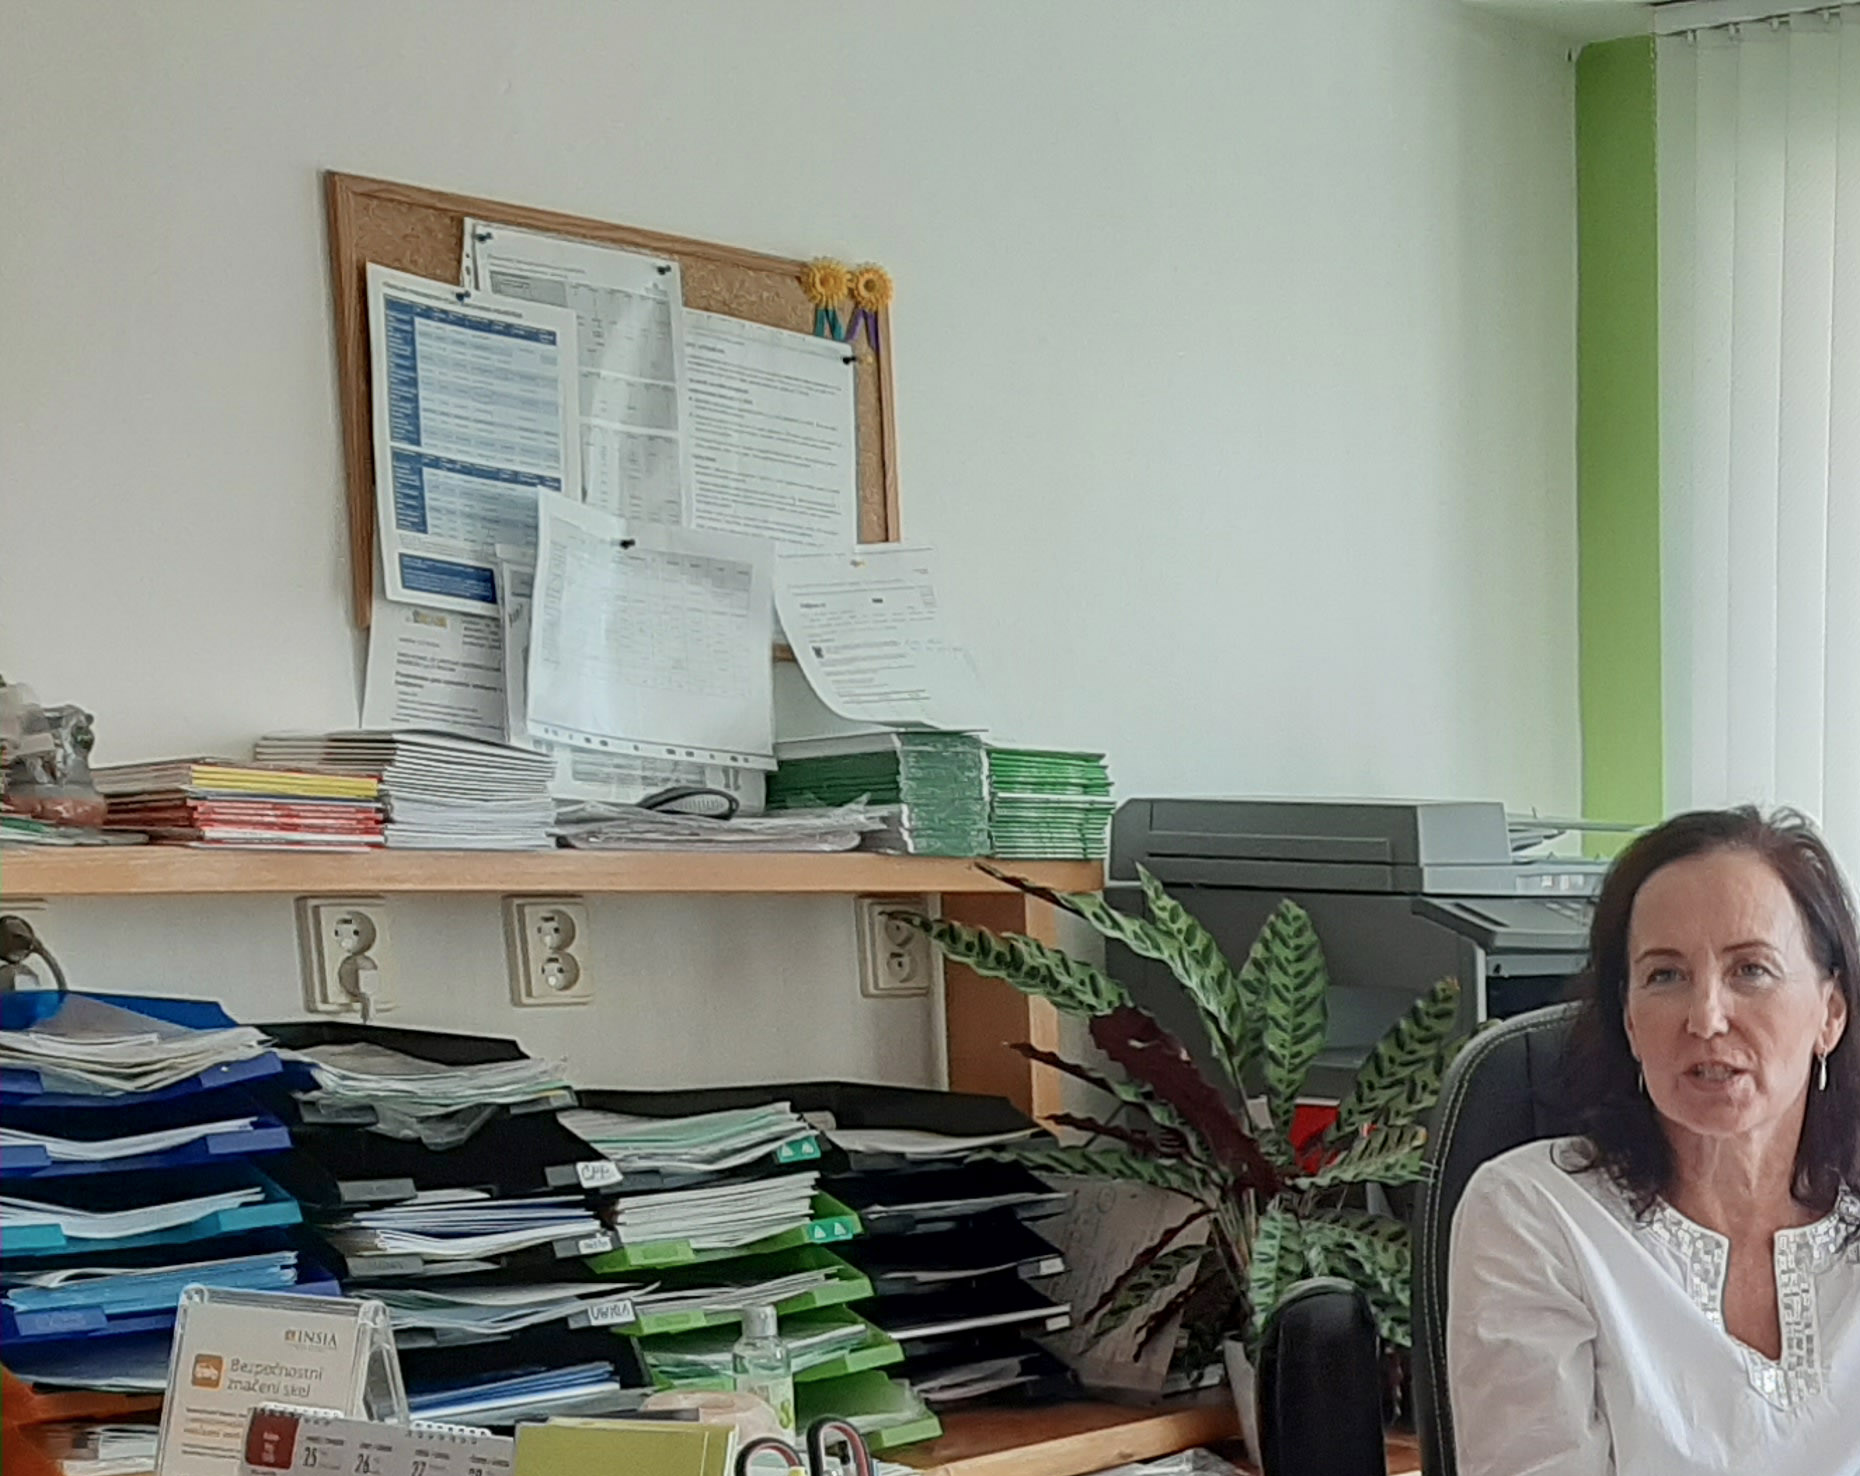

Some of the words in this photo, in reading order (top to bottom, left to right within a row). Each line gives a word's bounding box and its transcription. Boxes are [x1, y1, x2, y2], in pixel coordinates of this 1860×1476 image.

[298, 1330, 337, 1347] INSIA
[303, 1447, 317, 1467] 25
[355, 1454, 370, 1474] 26
